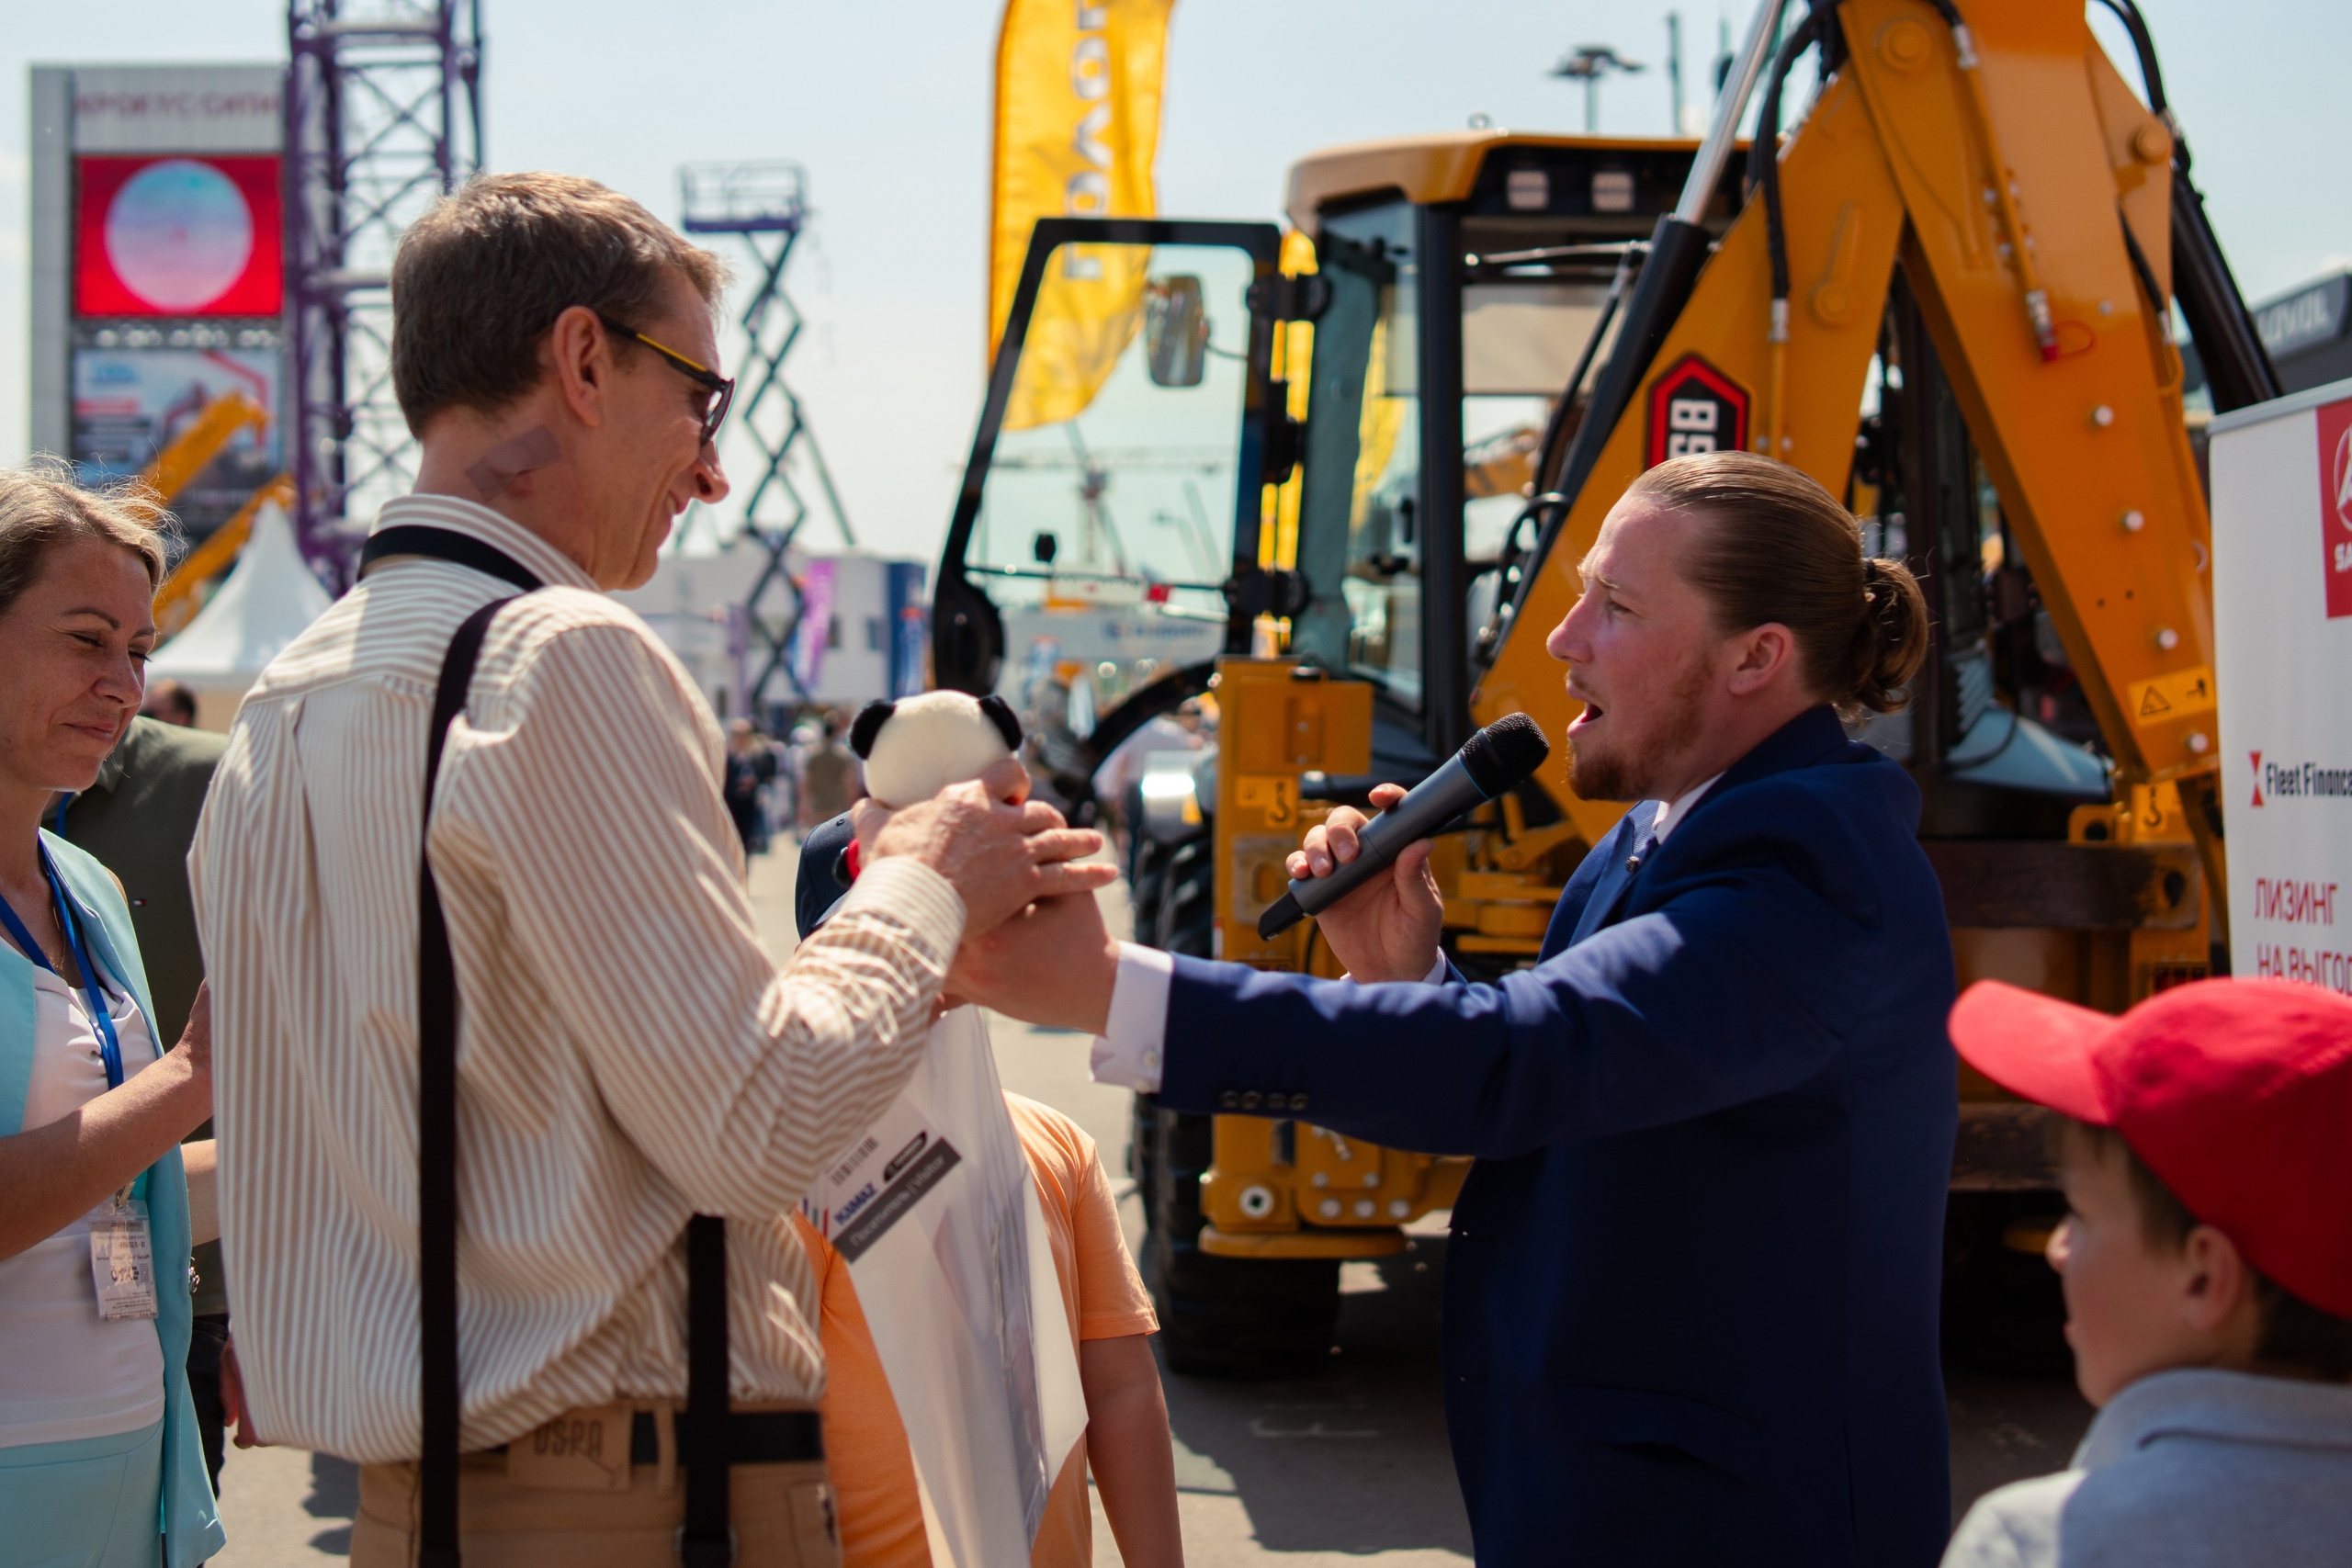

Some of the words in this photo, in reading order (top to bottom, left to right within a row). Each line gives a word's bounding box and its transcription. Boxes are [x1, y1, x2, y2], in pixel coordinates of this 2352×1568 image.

[2266, 761, 2301, 796] Fleet
[2256, 878, 2337, 925] ЛИЗИНГ
[2256, 942, 2284, 977] НА
[910, 1153, 946, 1188] Visitor
[832, 1182, 878, 1225] KAMAZ
